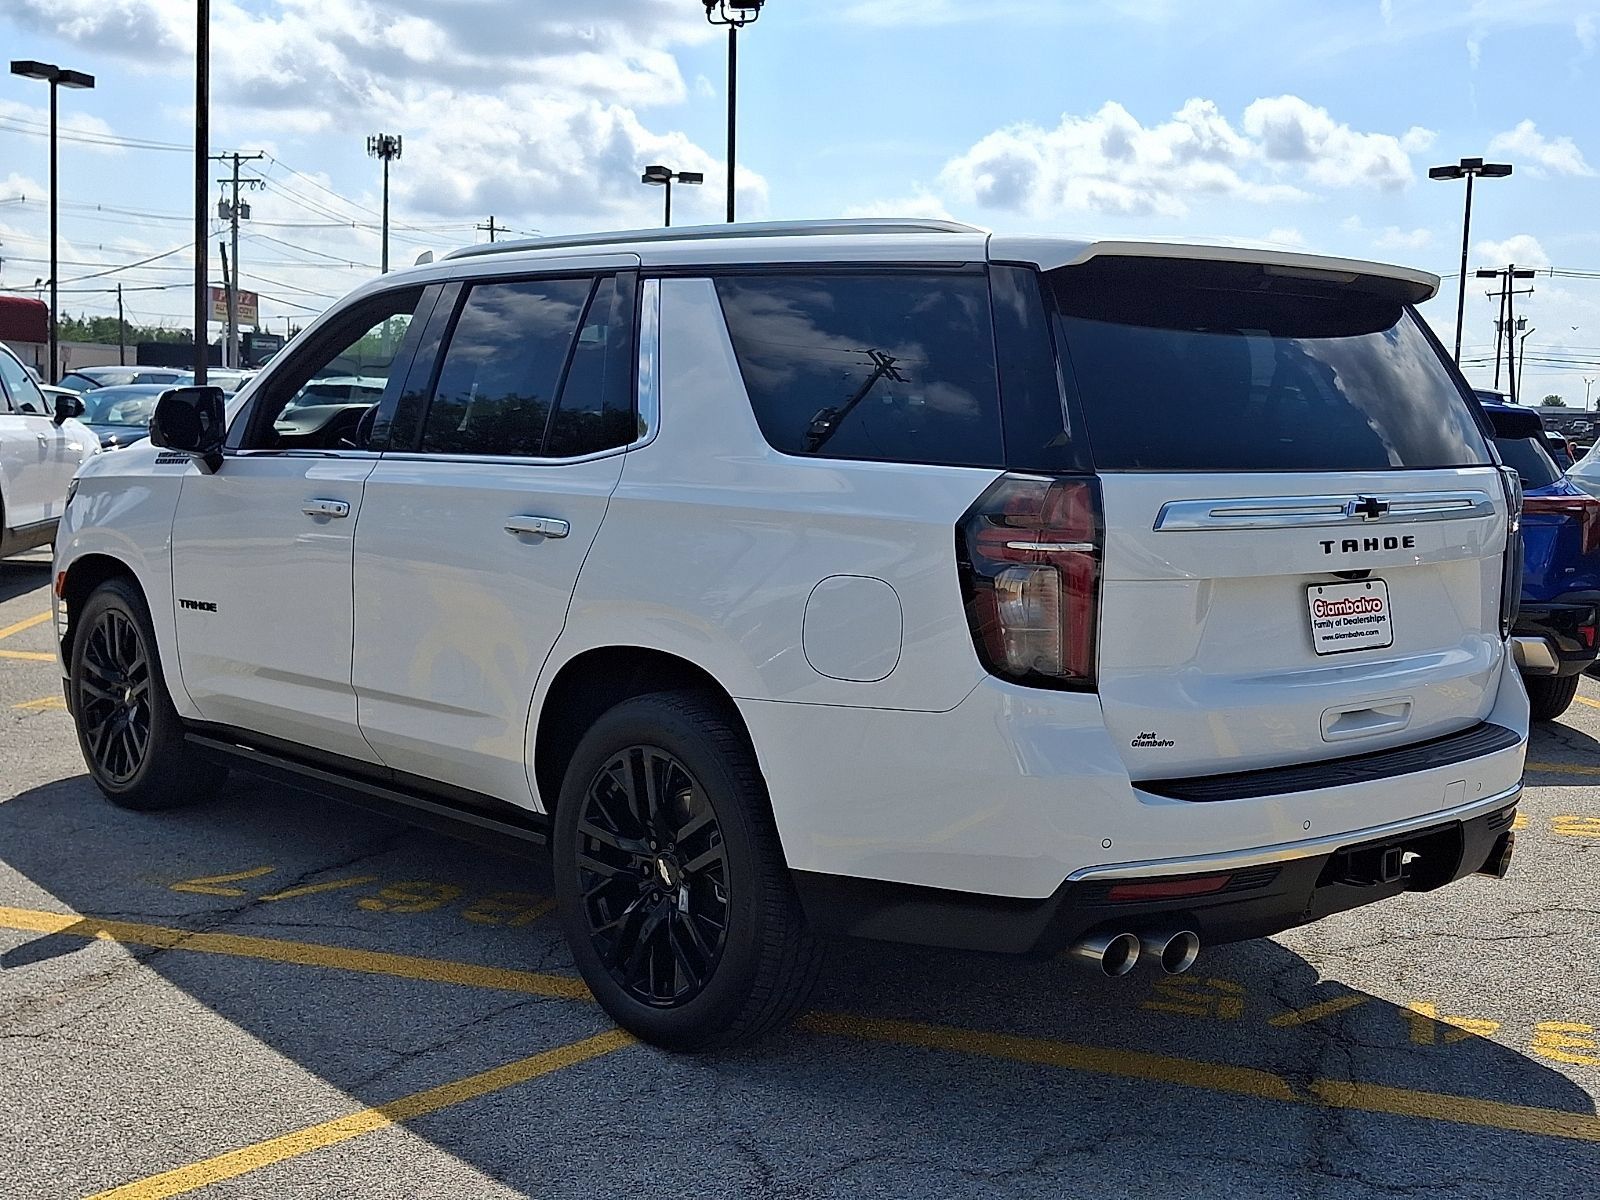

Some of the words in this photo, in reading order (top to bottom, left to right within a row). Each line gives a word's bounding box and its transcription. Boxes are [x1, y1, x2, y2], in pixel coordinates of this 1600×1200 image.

[1319, 535, 1416, 555] TAHOE
[178, 599, 218, 613] TAHOE
[1313, 597, 1383, 618] Giambalvo
[1313, 619, 1334, 629] Family
[1335, 618, 1342, 627] of
[1343, 614, 1387, 626] Dealerships
[1322, 630, 1379, 640] www.Giambalvo.com
[1137, 731, 1156, 739] Jack
[1131, 739, 1174, 747] Giambalvo
